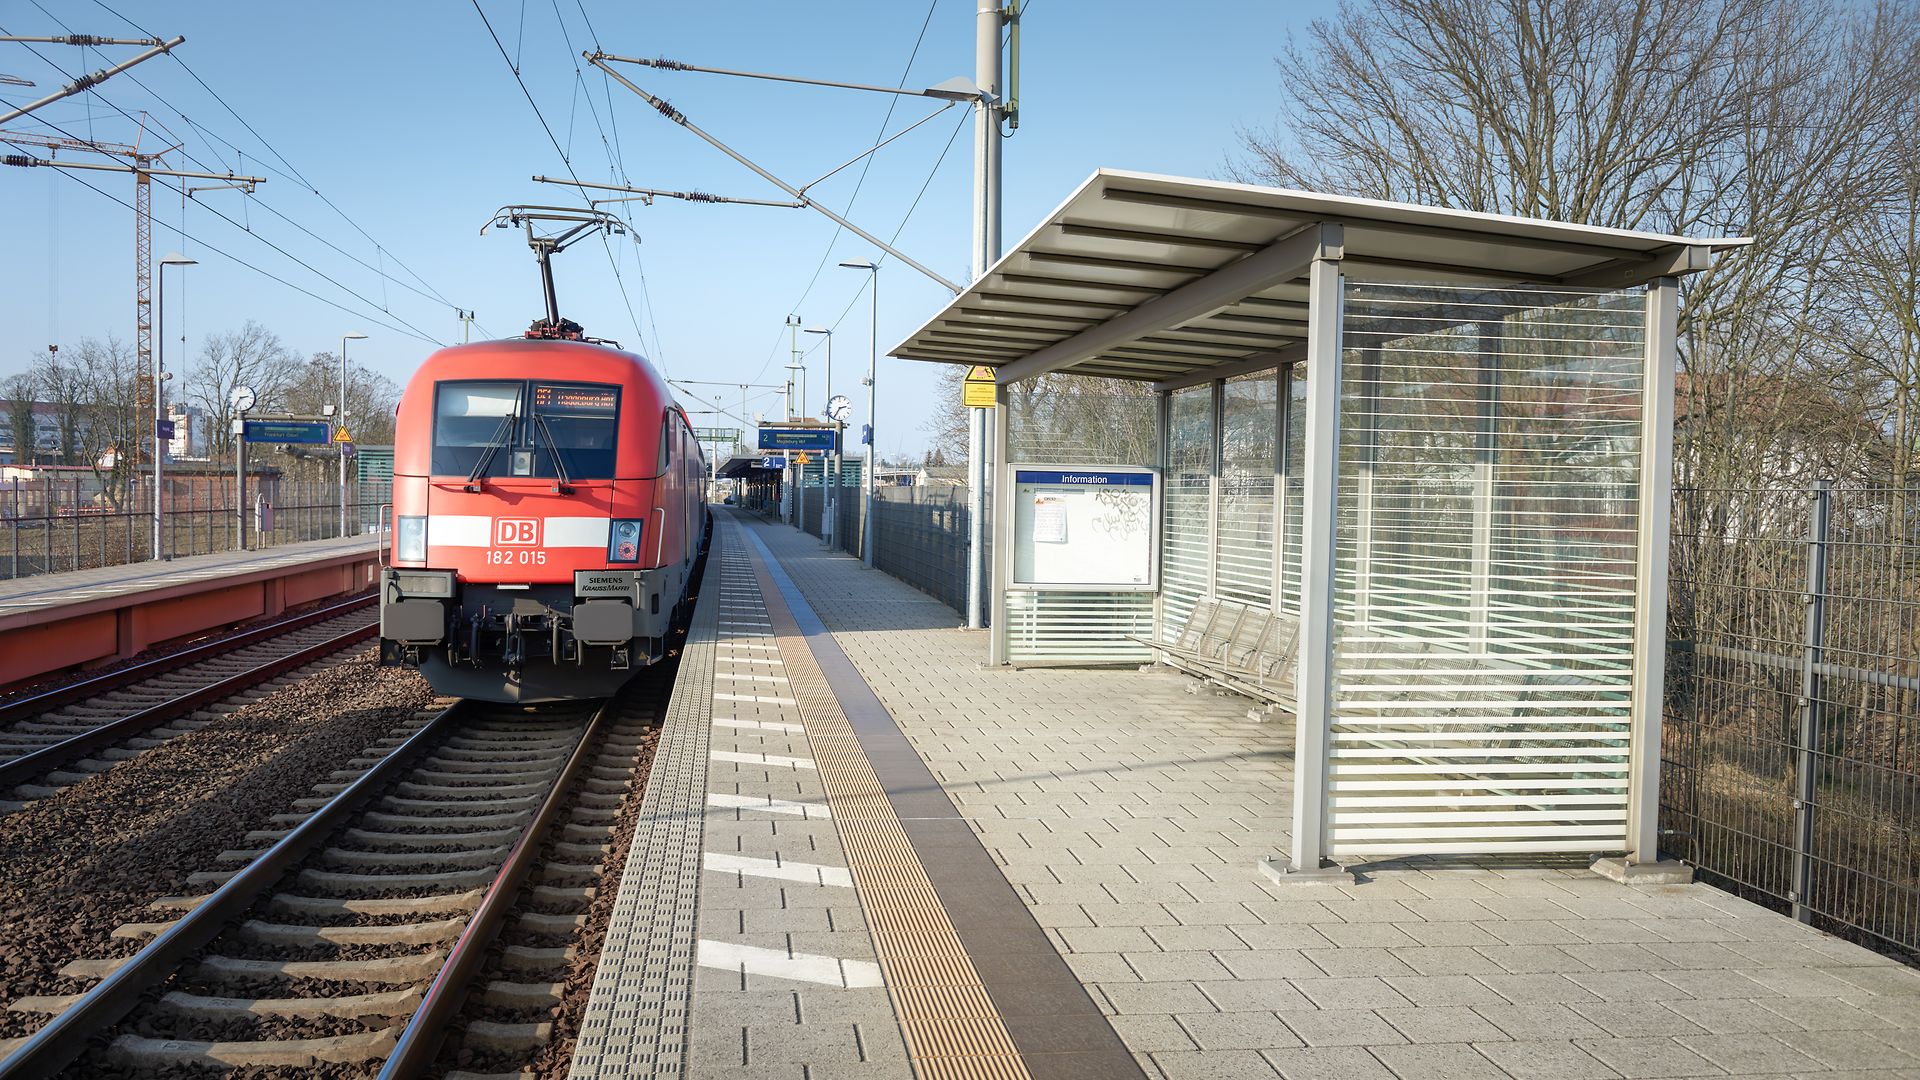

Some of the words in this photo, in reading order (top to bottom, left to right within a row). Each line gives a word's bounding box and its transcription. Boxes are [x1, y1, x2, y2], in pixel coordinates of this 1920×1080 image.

[763, 434, 768, 442] 2
[763, 457, 770, 468] 2
[1062, 475, 1108, 484] Information
[500, 522, 534, 542] DB
[486, 550, 513, 565] 182
[519, 550, 546, 565] 015
